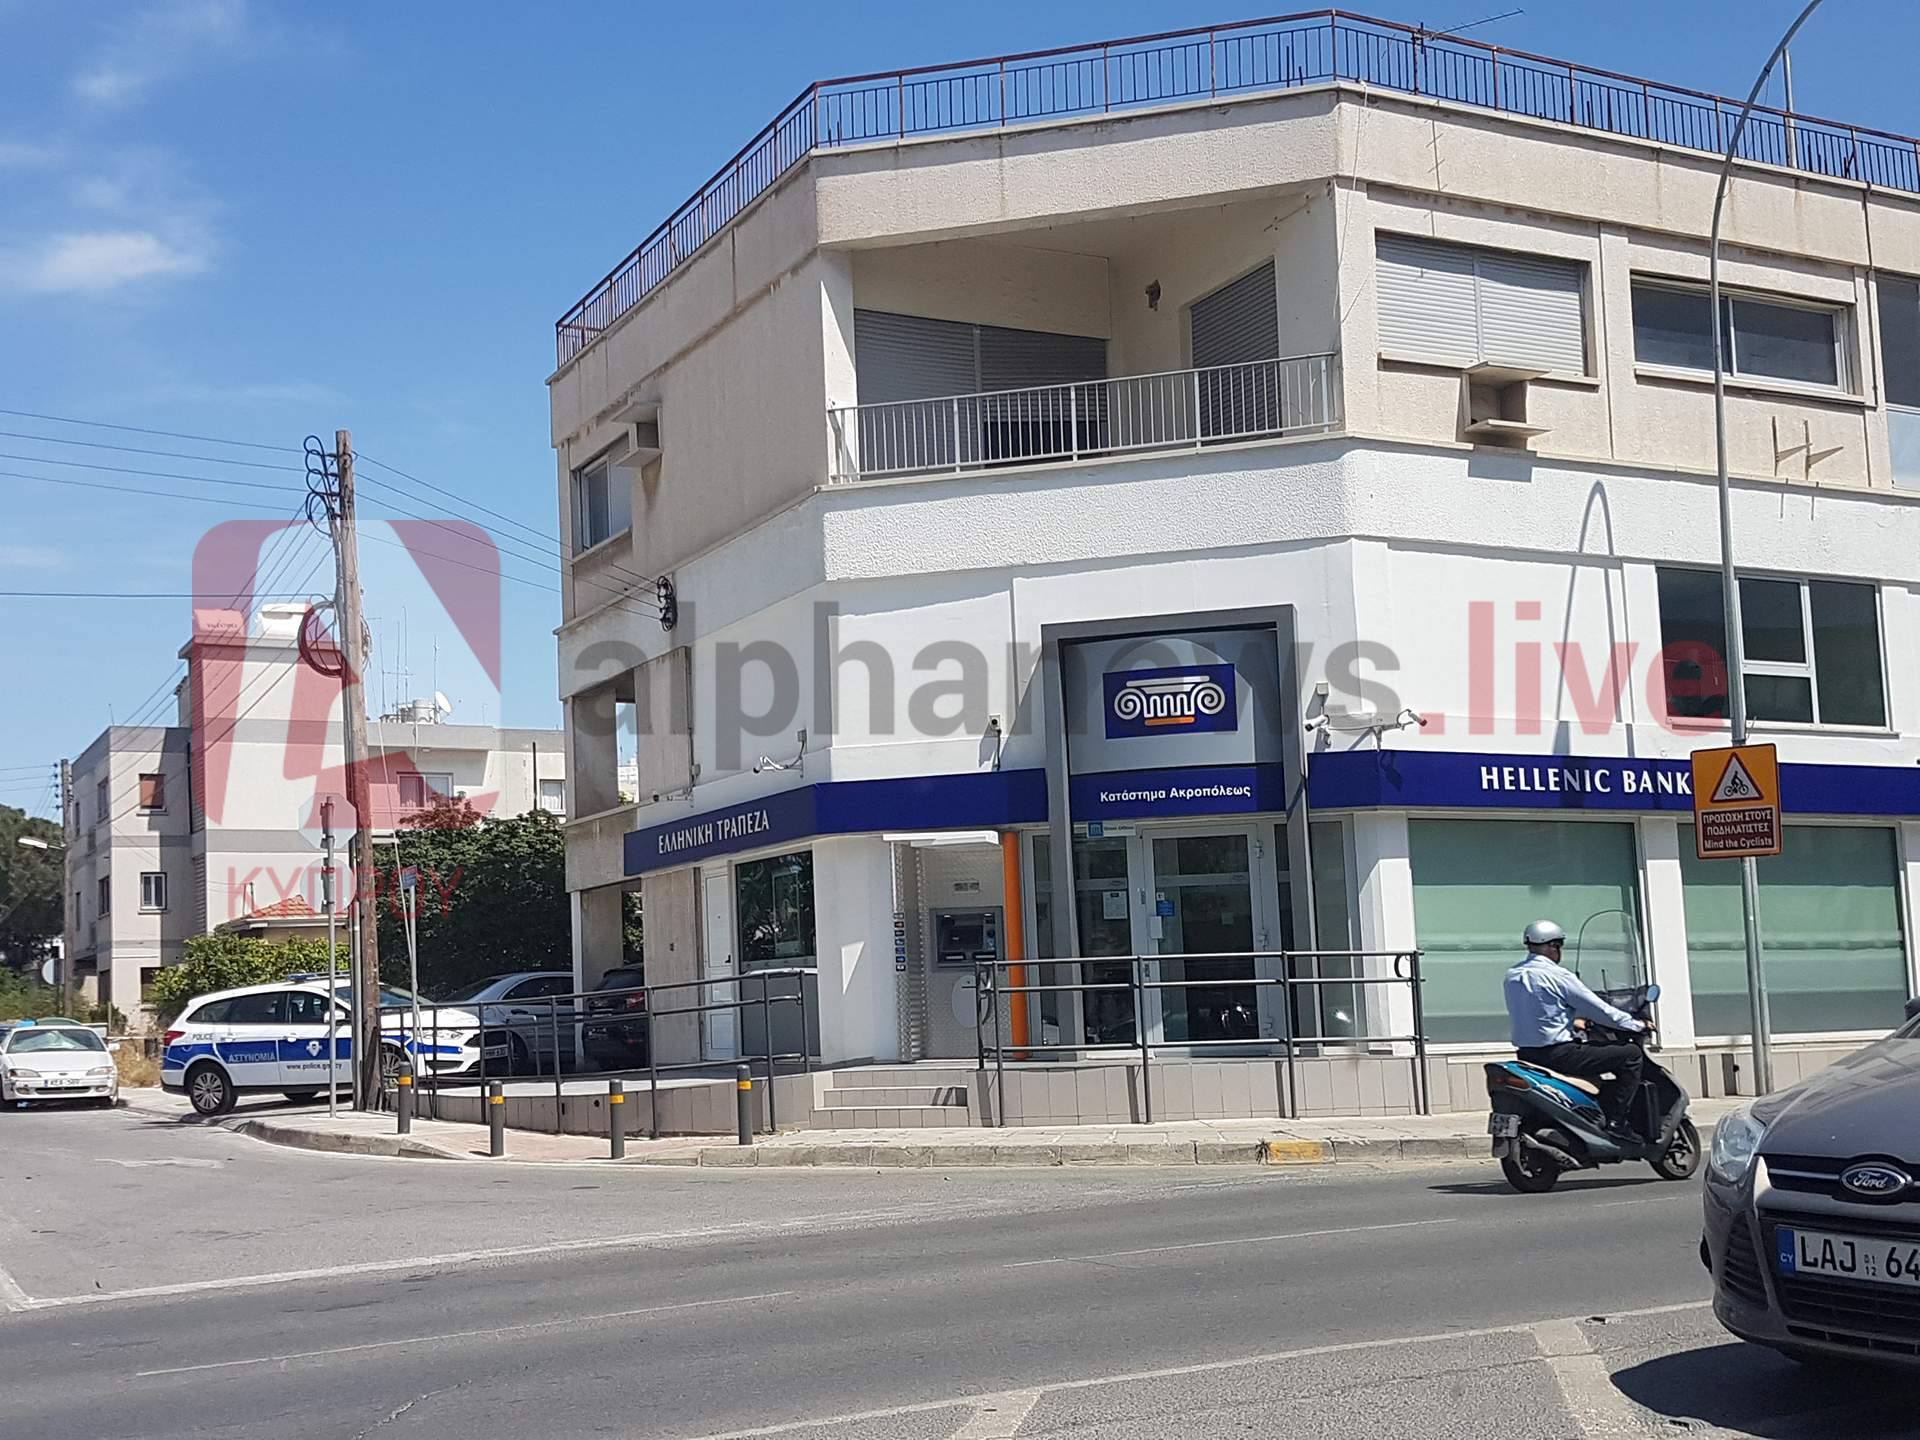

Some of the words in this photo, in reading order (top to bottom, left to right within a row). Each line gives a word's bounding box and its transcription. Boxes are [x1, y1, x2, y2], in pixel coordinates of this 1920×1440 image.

[1480, 765, 1610, 793] HELLENIC
[1622, 769, 1692, 795] BANK
[1100, 789, 1166, 802] Κατάστημα
[1169, 784, 1251, 799] Ακροπόλεως
[1703, 813, 1743, 824] ΠΡΟΣΟΧΗ
[1745, 810, 1772, 821] ΣΤΟΥΣ
[658, 821, 713, 854] ΕΛΛΗΝΙΚΗ
[716, 809, 770, 841] ΤΡΑΠΕΖΑ
[1707, 823, 1769, 835] ΠΟΔΗΛΑΤΙΣΤΕΣ
[1704, 839, 1723, 849] Mind
[1725, 838, 1738, 848] the
[1740, 838, 1773, 849] Cyclists
[192, 1032, 214, 1041] POLICE
[228, 1051, 276, 1063] ΑΣΤΥΝΟΜΙΑ
[1853, 1170, 1889, 1188] Ford
[1780, 1253, 1794, 1264] CY
[1800, 1235, 1857, 1273] LAJ
